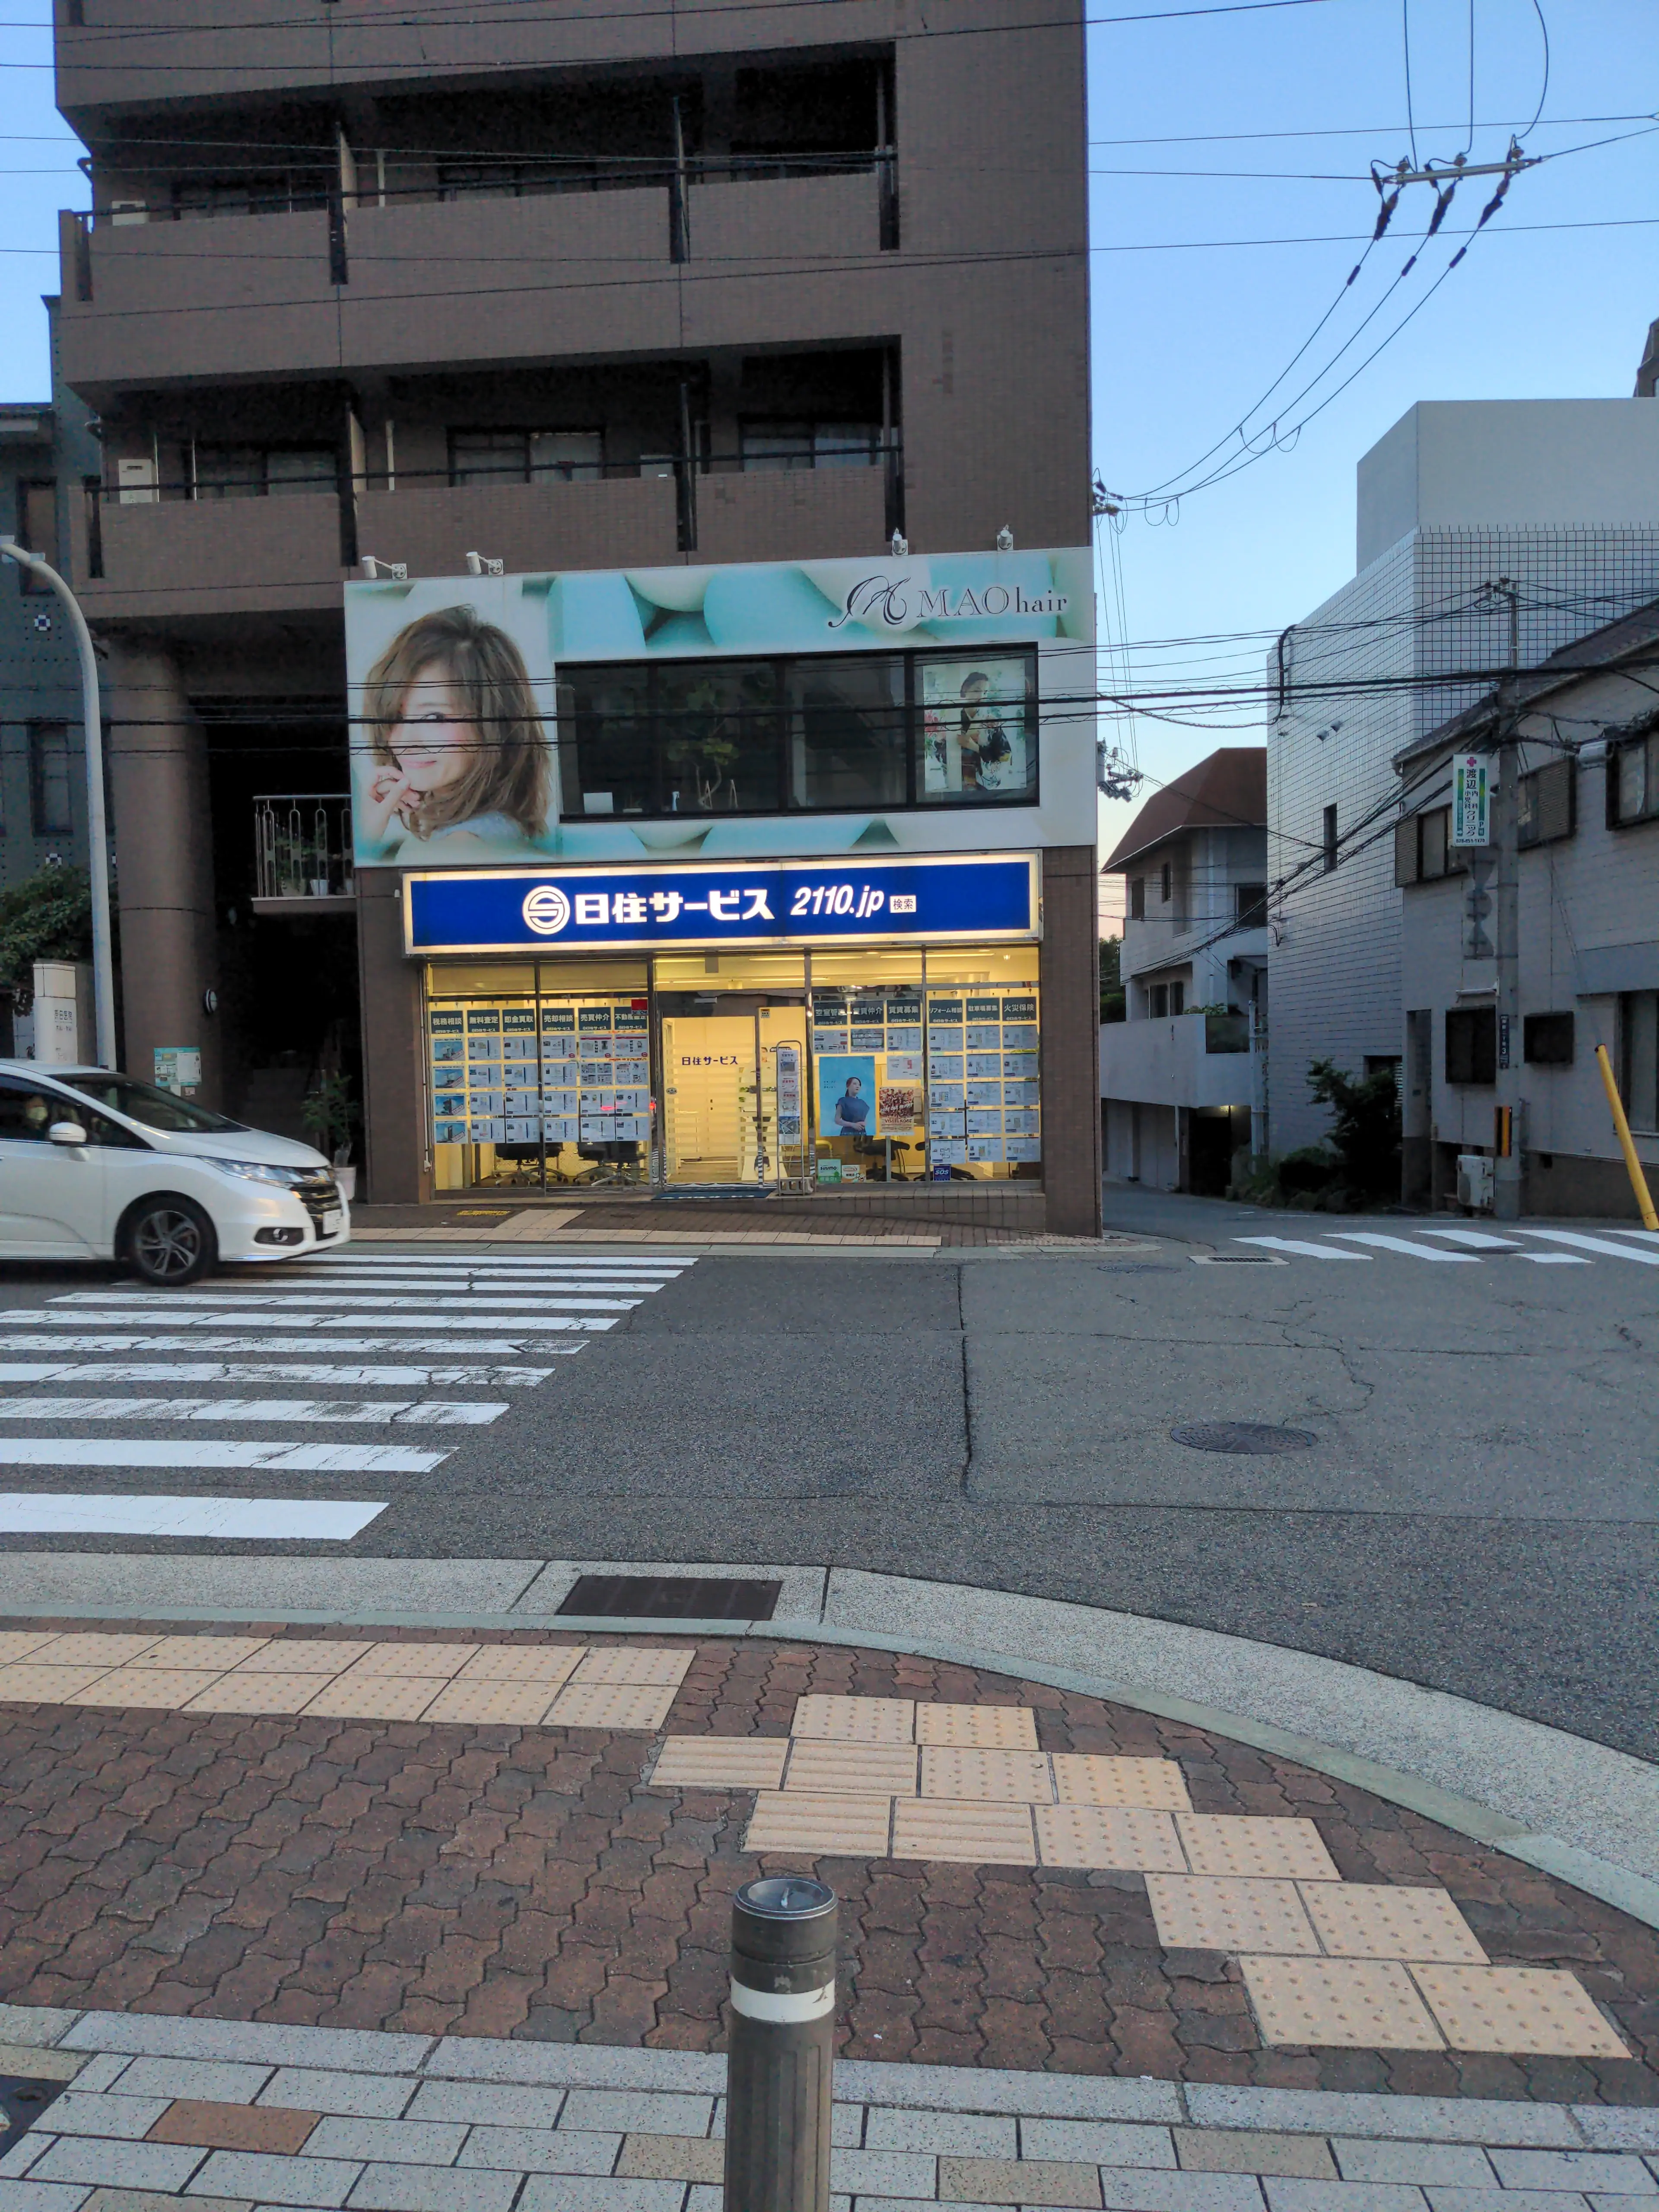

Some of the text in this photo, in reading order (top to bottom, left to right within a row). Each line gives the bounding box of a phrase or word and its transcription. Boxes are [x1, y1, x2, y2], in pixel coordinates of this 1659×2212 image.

[916, 586, 1009, 618] MAO
[1016, 586, 1067, 613] hair
[575, 885, 913, 925] 日住サービス 2110.jp 検索
[889, 1006, 918, 1014] 賃貸募集
[1004, 1004, 1035, 1012] 火災保険
[433, 1017, 462, 1026] 税務相談
[469, 1016, 498, 1024] 無料査定
[505, 1015, 534, 1023] 即金買取
[544, 1014, 573, 1023] 売却相談
[581, 1013, 610, 1022] 売買仲介
[682, 1056, 738, 1065] 日住サービス
